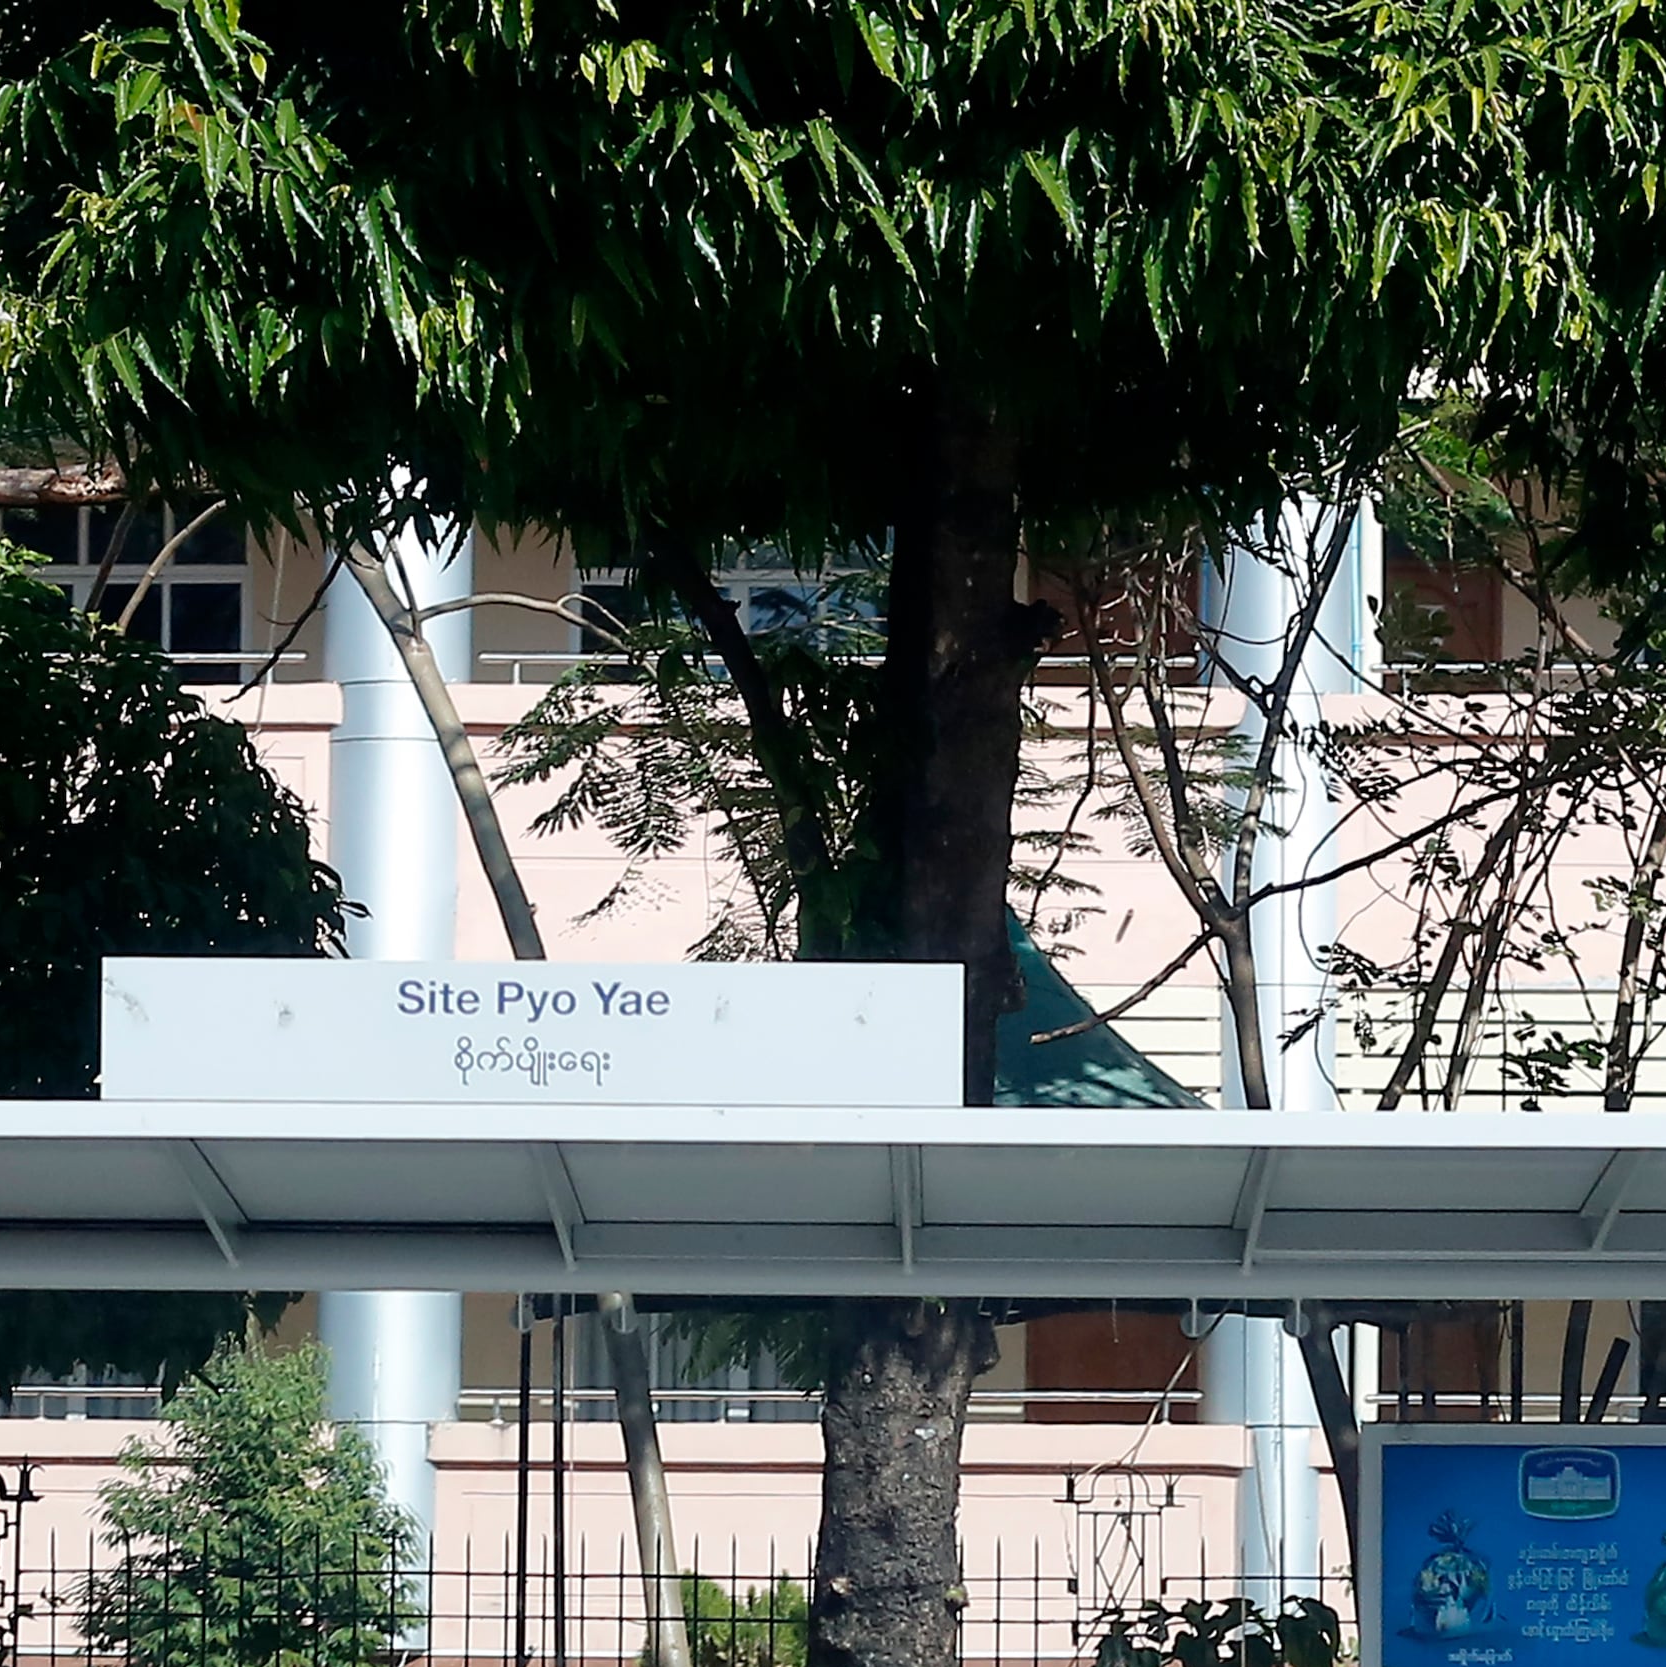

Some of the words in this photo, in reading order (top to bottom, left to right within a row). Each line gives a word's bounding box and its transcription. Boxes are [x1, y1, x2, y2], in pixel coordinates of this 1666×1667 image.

[397, 979, 481, 1015] Site
[497, 981, 577, 1023] Pyo
[591, 981, 670, 1017] Yae
[454, 1036, 611, 1087] စိုက်ပျိုးရေး
